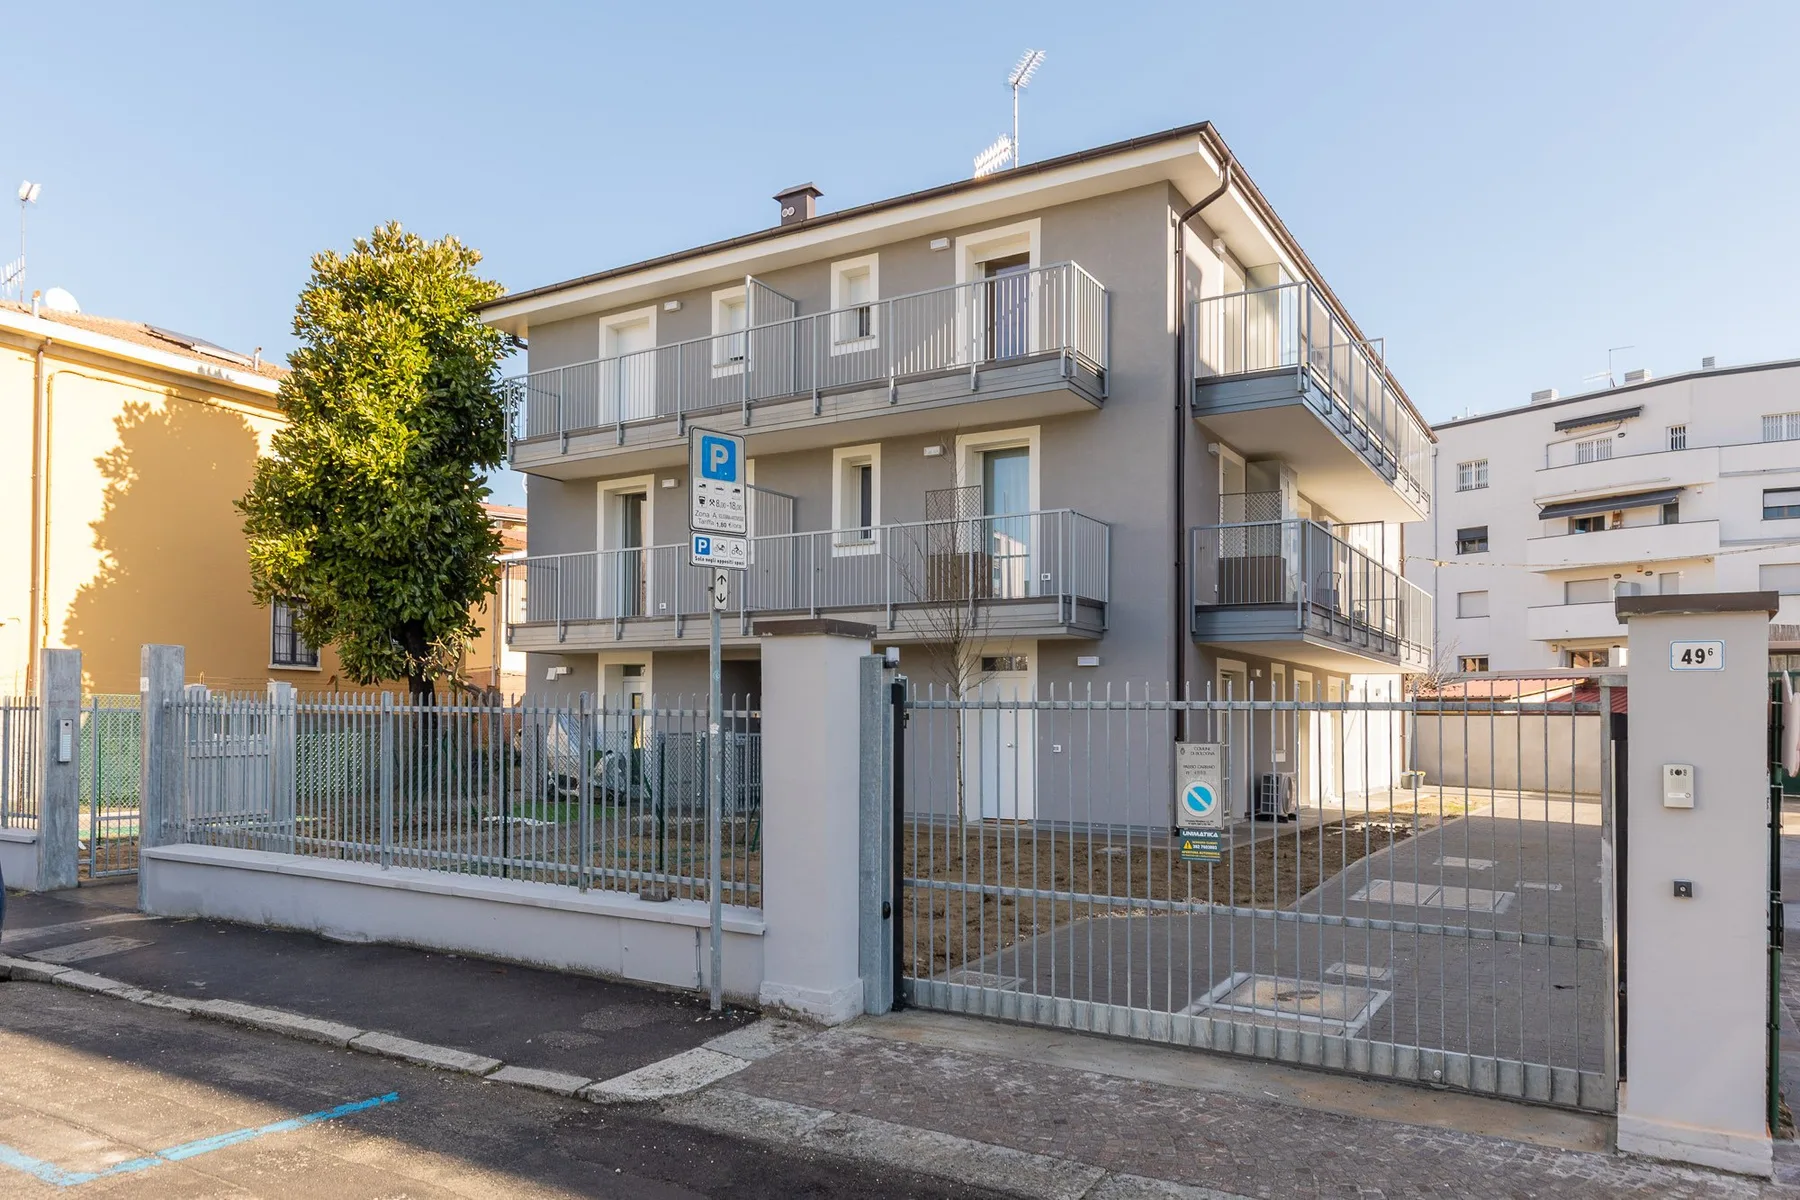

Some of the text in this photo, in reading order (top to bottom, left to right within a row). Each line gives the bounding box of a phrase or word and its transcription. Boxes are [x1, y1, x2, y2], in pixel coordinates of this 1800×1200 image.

[710, 443, 729, 473] P
[695, 510, 710, 519] Zona
[698, 518, 715, 526] Tariffa
[698, 539, 707, 552] P
